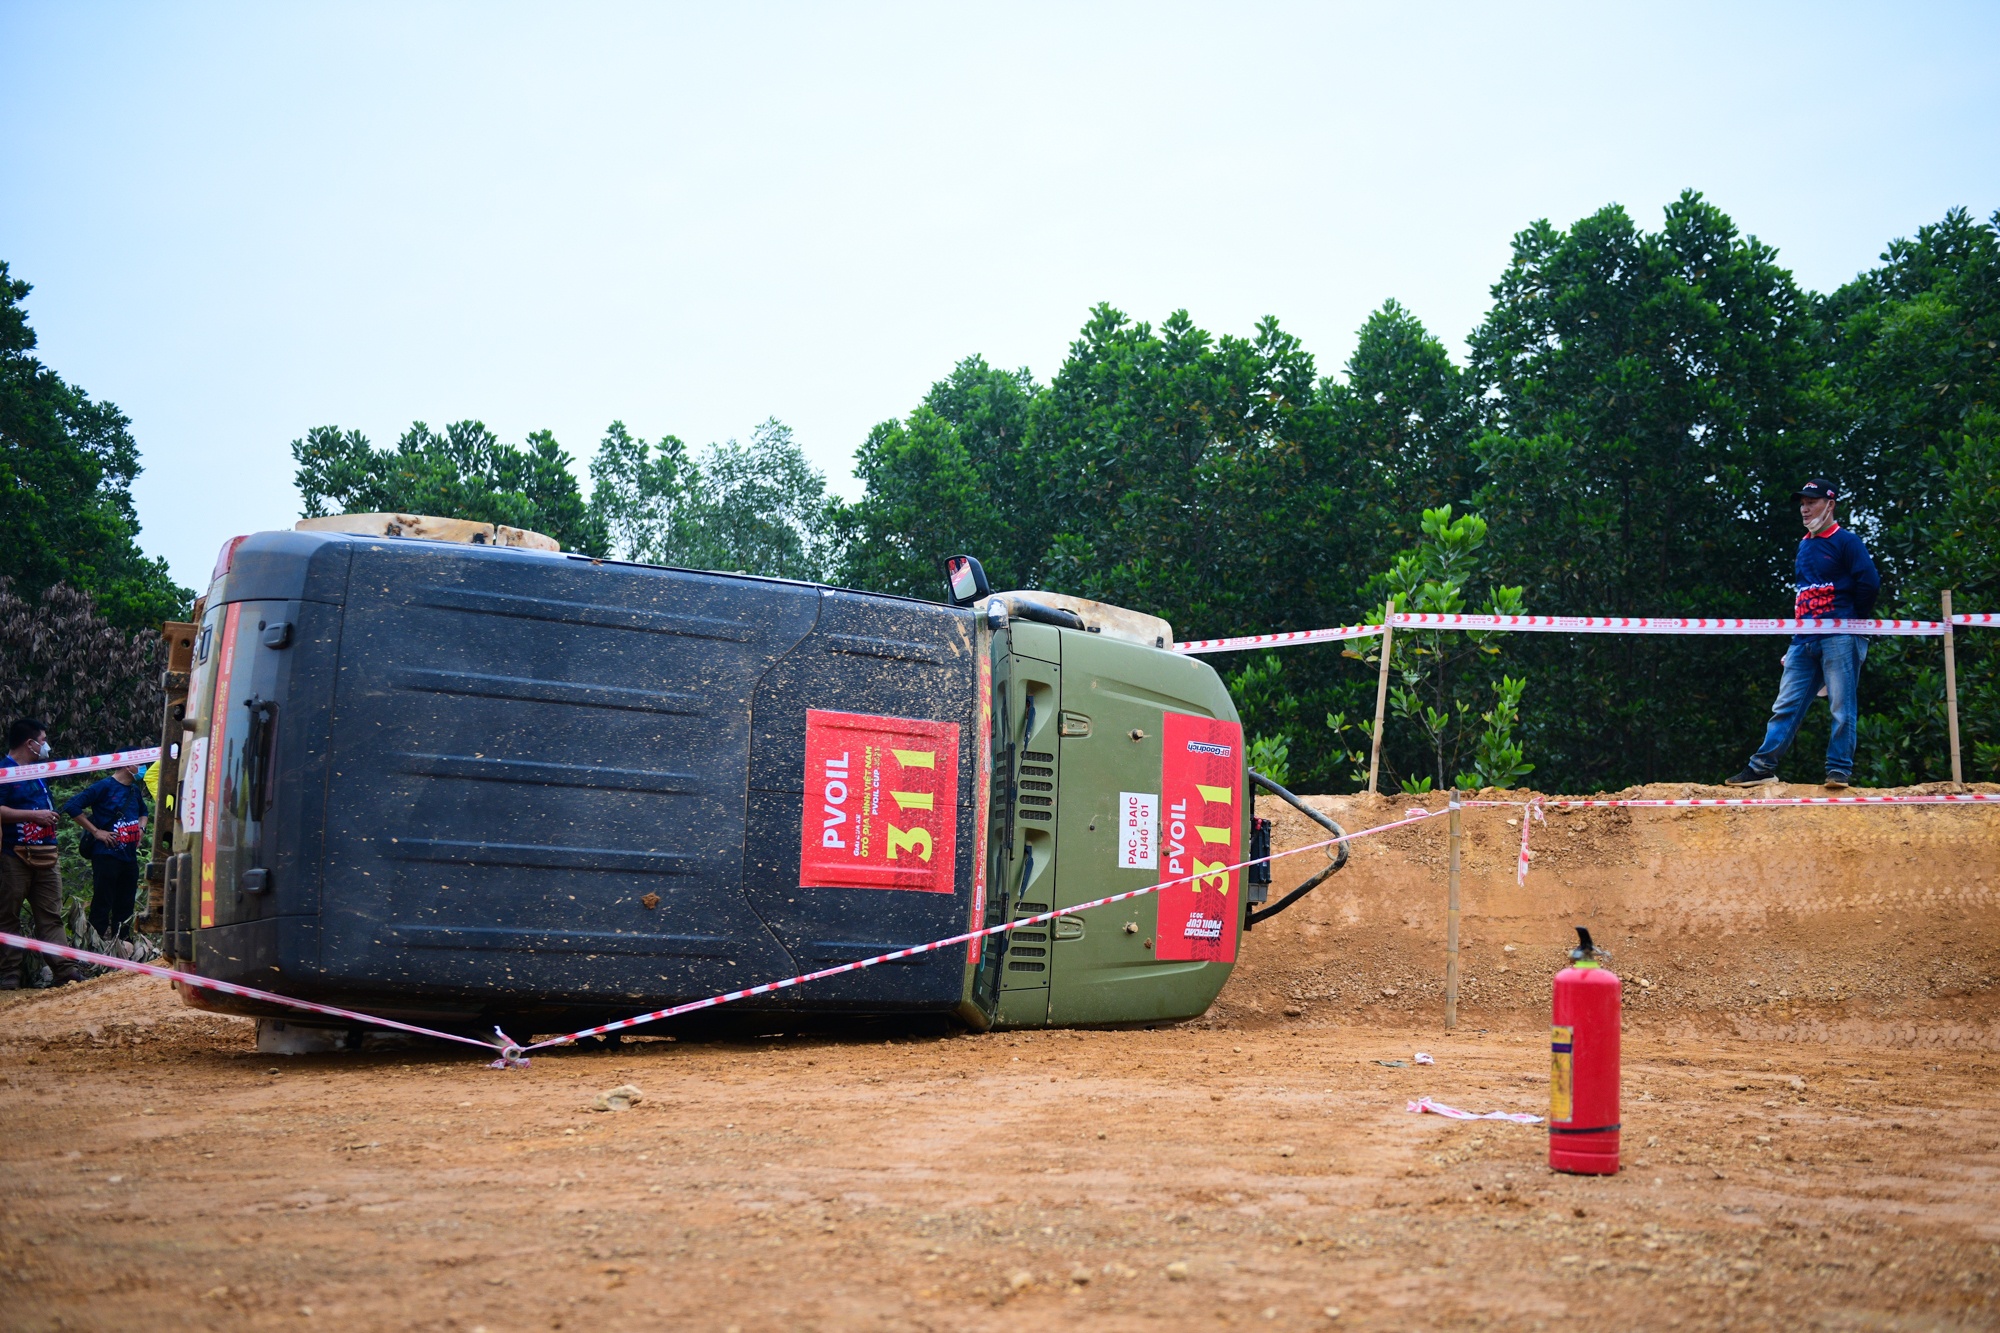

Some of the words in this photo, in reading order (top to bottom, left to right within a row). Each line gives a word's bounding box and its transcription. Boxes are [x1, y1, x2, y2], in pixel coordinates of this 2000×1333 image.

[1188, 743, 1230, 757] BFGoodrich
[822, 752, 849, 848] PVOIL
[872, 789, 880, 816] PVOIL
[886, 749, 936, 863] 311
[1129, 796, 1138, 826] BAIC
[1140, 804, 1149, 817] 01
[1140, 830, 1148, 860] BJ40
[1169, 798, 1186, 874] PVOIL
[1192, 784, 1232, 896] 311
[1128, 839, 1138, 865] PAC
[202, 862, 214, 926] 311
[1184, 928, 1220, 937] OFFROAD
[1186, 918, 1202, 928] CUP
[1202, 920, 1222, 929] PVOIL
